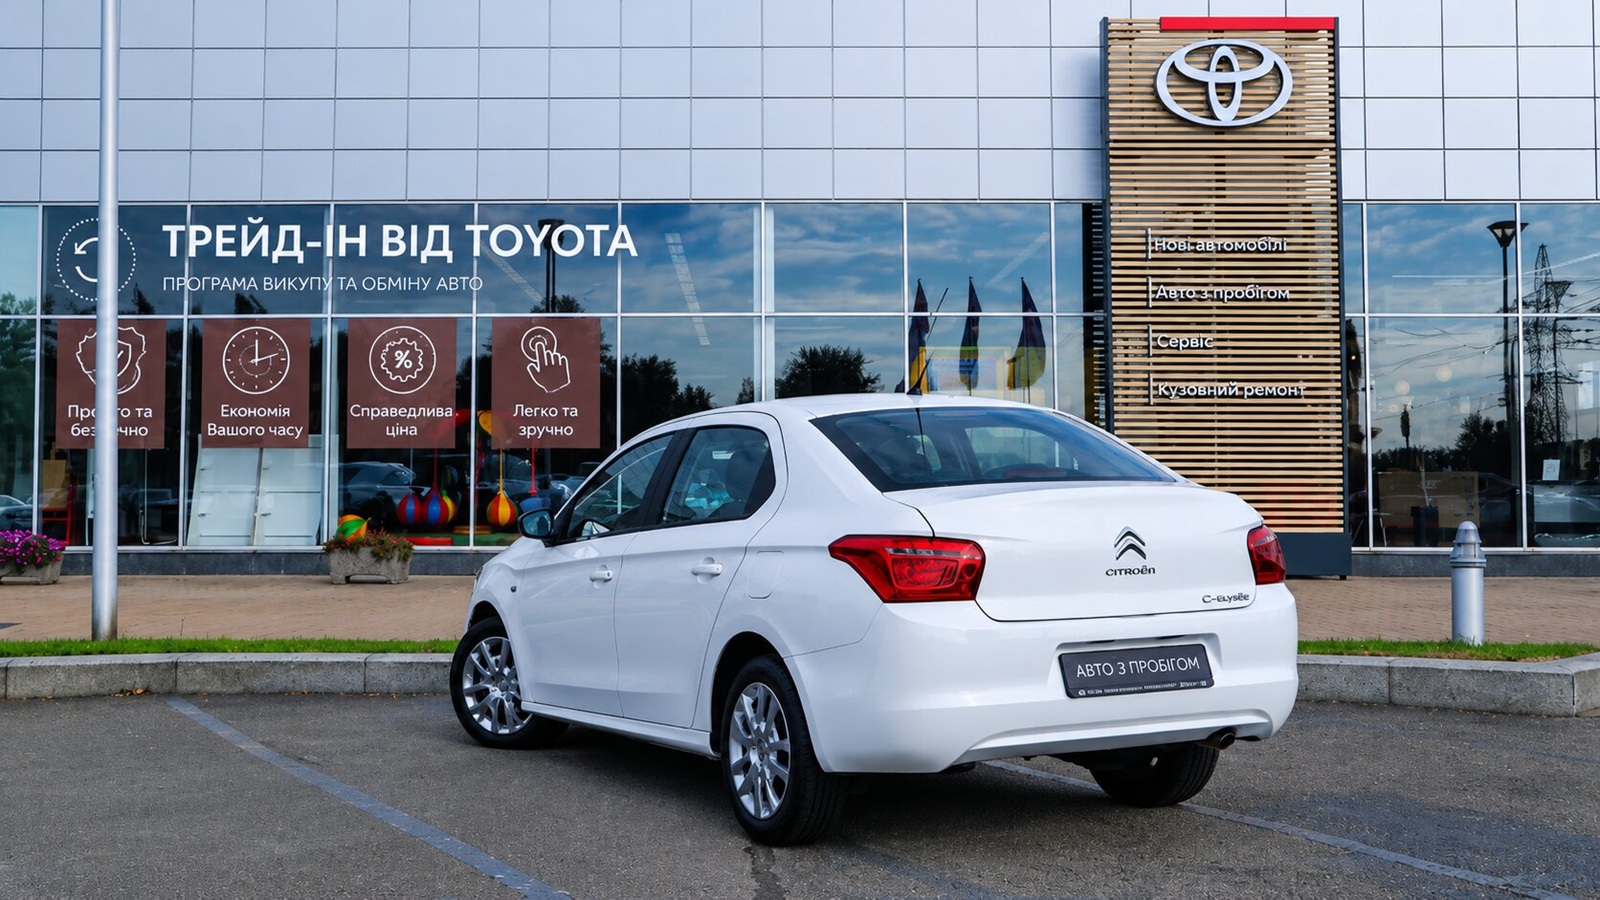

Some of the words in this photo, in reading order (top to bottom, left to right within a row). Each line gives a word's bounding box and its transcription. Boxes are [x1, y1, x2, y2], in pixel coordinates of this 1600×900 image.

[162, 216, 366, 264] ТРЕЙД-ІН
[382, 224, 453, 264] ВІД
[465, 223, 638, 258] TOYOTA
[1154, 236, 1191, 252] Нові
[1196, 236, 1287, 252] автомобілі
[163, 276, 258, 291] ПРОГРАМА
[263, 276, 331, 291] ВИКУПУ
[337, 276, 358, 291] ТА
[362, 276, 431, 291] ОБМІНУ
[436, 276, 483, 291] АВТО
[1155, 284, 1196, 300] Авто
[1200, 287, 1208, 300] з
[1213, 284, 1290, 303] пробігом
[1157, 334, 1214, 351] Сервіс
[1158, 381, 1239, 399] Кузовний
[1244, 385, 1306, 400] ремонт
[68, 404, 131, 421] Про
[135, 407, 153, 418] та
[220, 404, 290, 418] Економія
[350, 404, 453, 421] Справедлива
[512, 404, 559, 418] Легко
[562, 406, 578, 418] та
[70, 423, 149, 437] безчно
[207, 423, 265, 437] Вашого
[268, 425, 303, 440] часу
[386, 423, 418, 438] ціна
[518, 425, 574, 440] зручно
[1076, 662, 1114, 678] АВТО
[1129, 656, 1200, 675] ПРОБІГОМ
